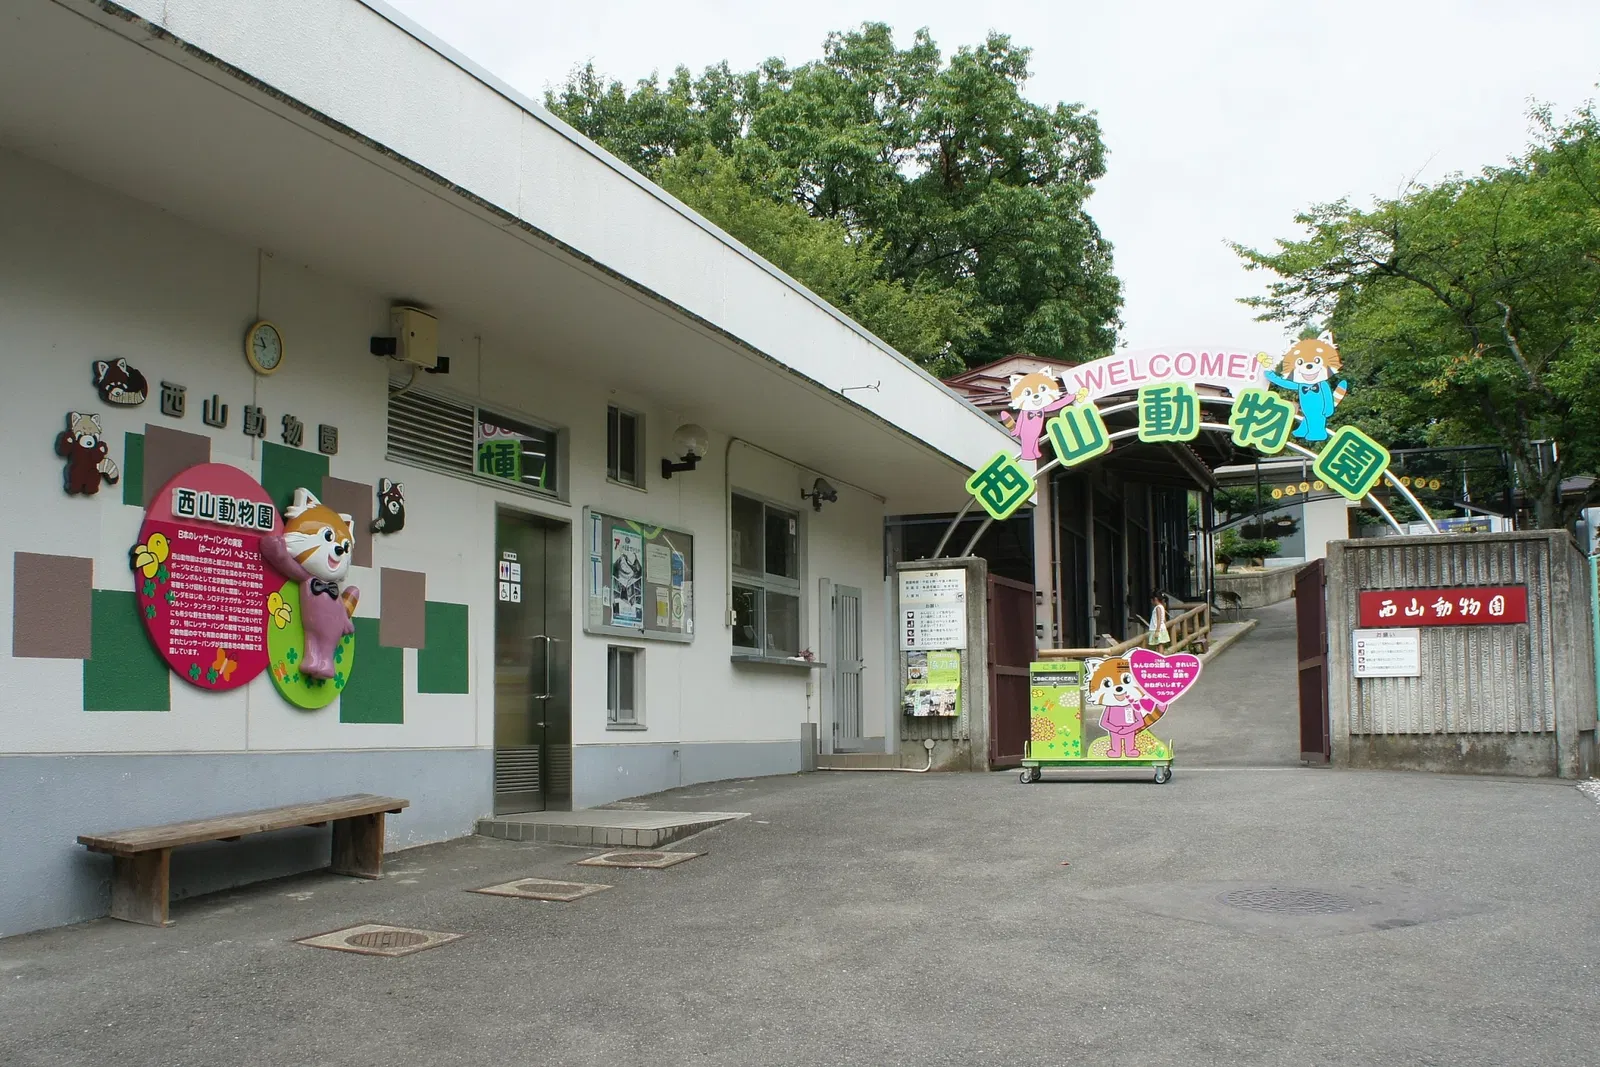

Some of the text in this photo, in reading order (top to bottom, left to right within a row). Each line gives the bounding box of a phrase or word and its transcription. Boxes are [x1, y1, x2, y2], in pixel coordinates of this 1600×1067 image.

[1074, 352, 1259, 394] WELCOME!
[160, 381, 338, 454] 西山動物園
[178, 489, 274, 529] 西山動物園
[1379, 595, 1505, 618] 西山動物園
